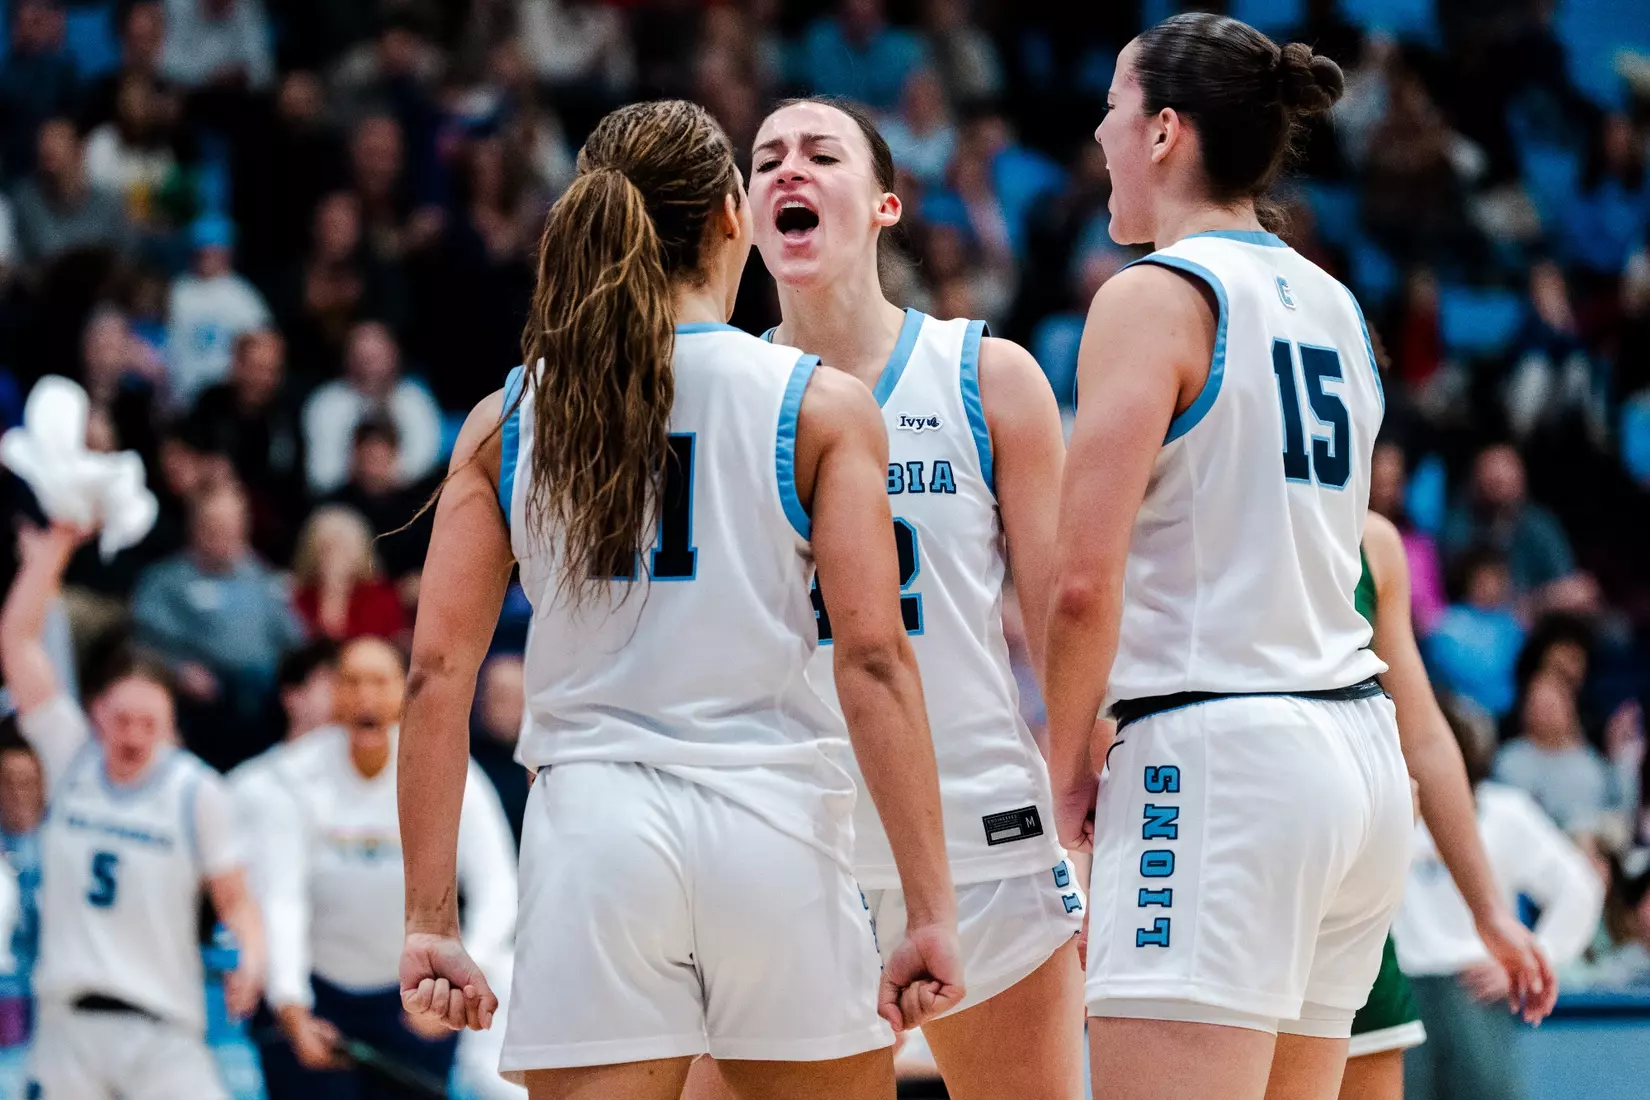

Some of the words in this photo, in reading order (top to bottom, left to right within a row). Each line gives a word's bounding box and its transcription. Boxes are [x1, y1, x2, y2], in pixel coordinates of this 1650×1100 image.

[900, 416, 925, 430] Ivy
[1270, 336, 1352, 490] 15
[1025, 816, 1035, 828] M
[1136, 765, 1180, 947] LIONS
